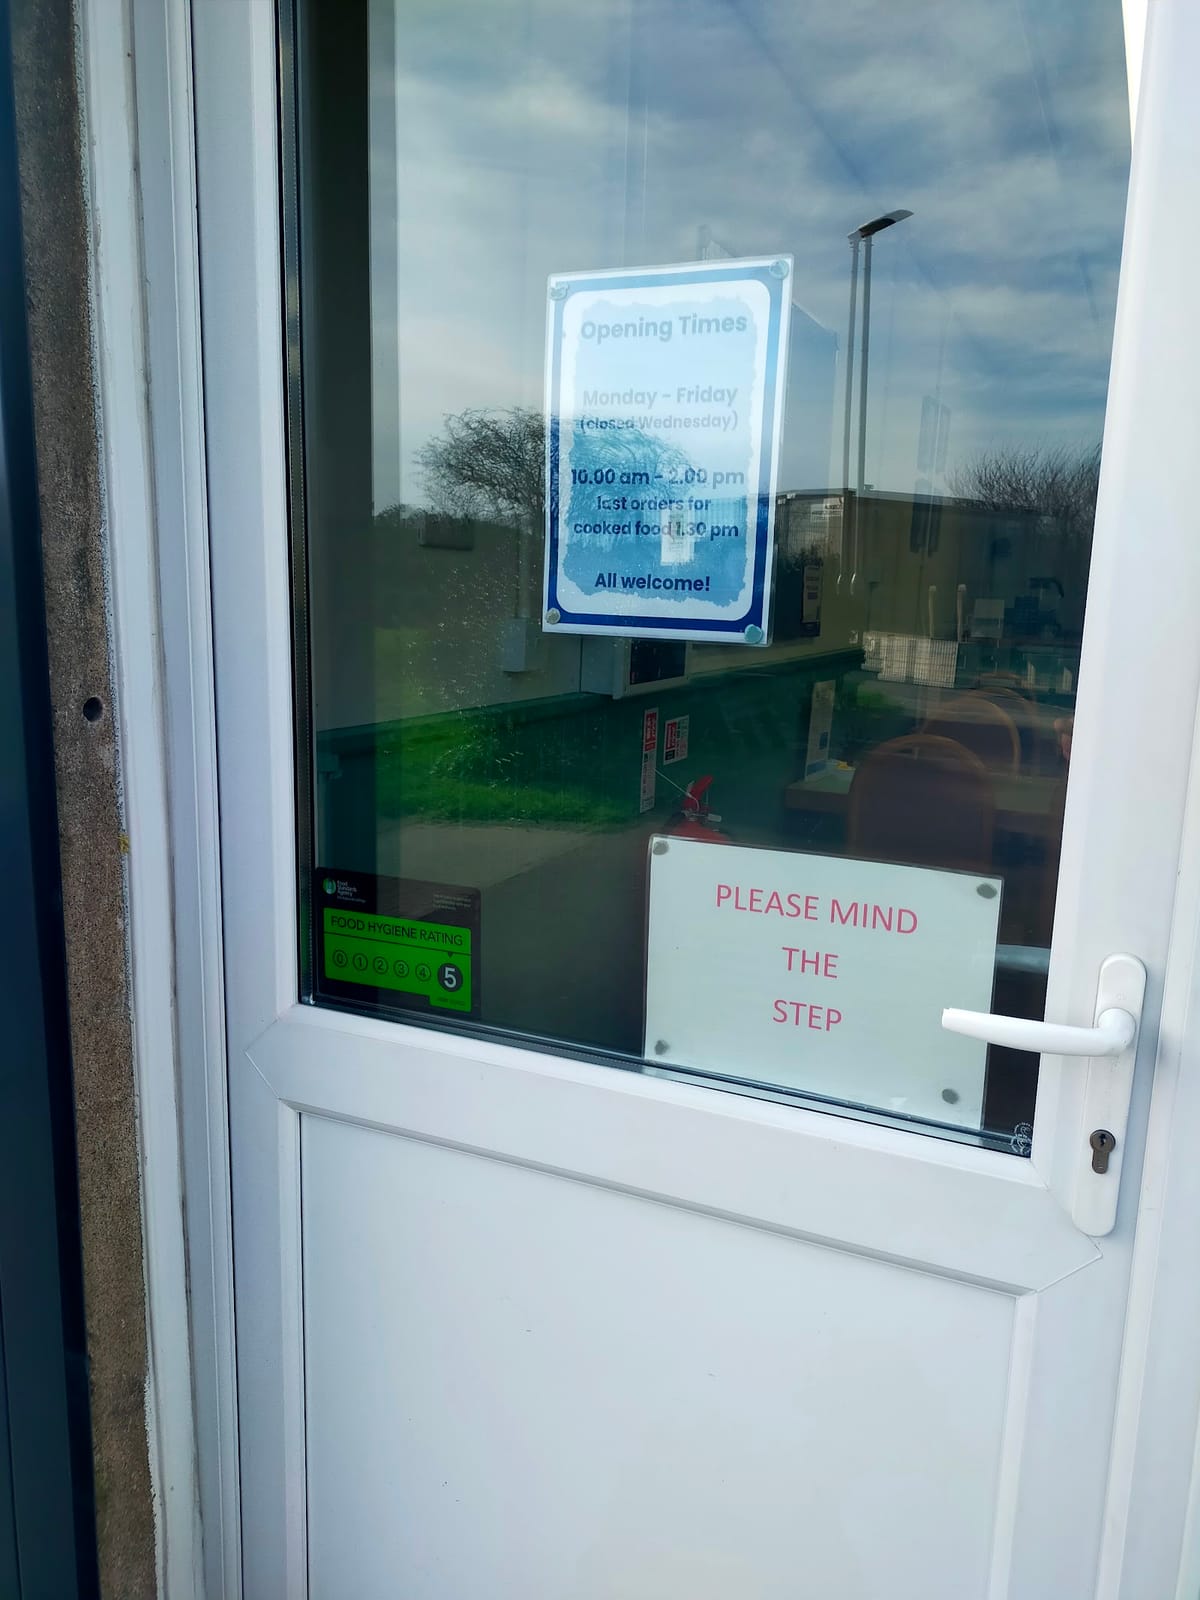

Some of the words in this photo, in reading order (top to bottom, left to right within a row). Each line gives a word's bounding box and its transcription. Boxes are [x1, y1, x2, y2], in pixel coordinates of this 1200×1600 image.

[581, 316, 673, 344] Opening
[679, 312, 748, 336] Times
[583, 388, 657, 409] Monday
[677, 384, 738, 405] Friday
[580, 414, 635, 434] (closed
[638, 410, 738, 432] Wednesday)
[571, 468, 616, 485] 10.00
[619, 471, 650, 485] am
[668, 467, 708, 485] 2.00
[712, 471, 745, 489] pm
[597, 495, 627, 511] last
[631, 495, 684, 511] orders
[688, 495, 712, 511] for
[573, 521, 632, 536] cooked
[635, 521, 672, 536] food
[675, 521, 707, 537] 1.30
[710, 523, 739, 541] pm
[594, 573, 617, 588] All
[620, 574, 711, 592] welcome!
[715, 884, 820, 921] PLEASE
[830, 898, 919, 935] MIND
[331, 915, 366, 931] FOOD
[368, 920, 417, 940] HYGIENE
[419, 930, 463, 946] RATING
[781, 946, 839, 979] THE
[443, 966, 457, 988] 5
[772, 999, 843, 1032] STEP
